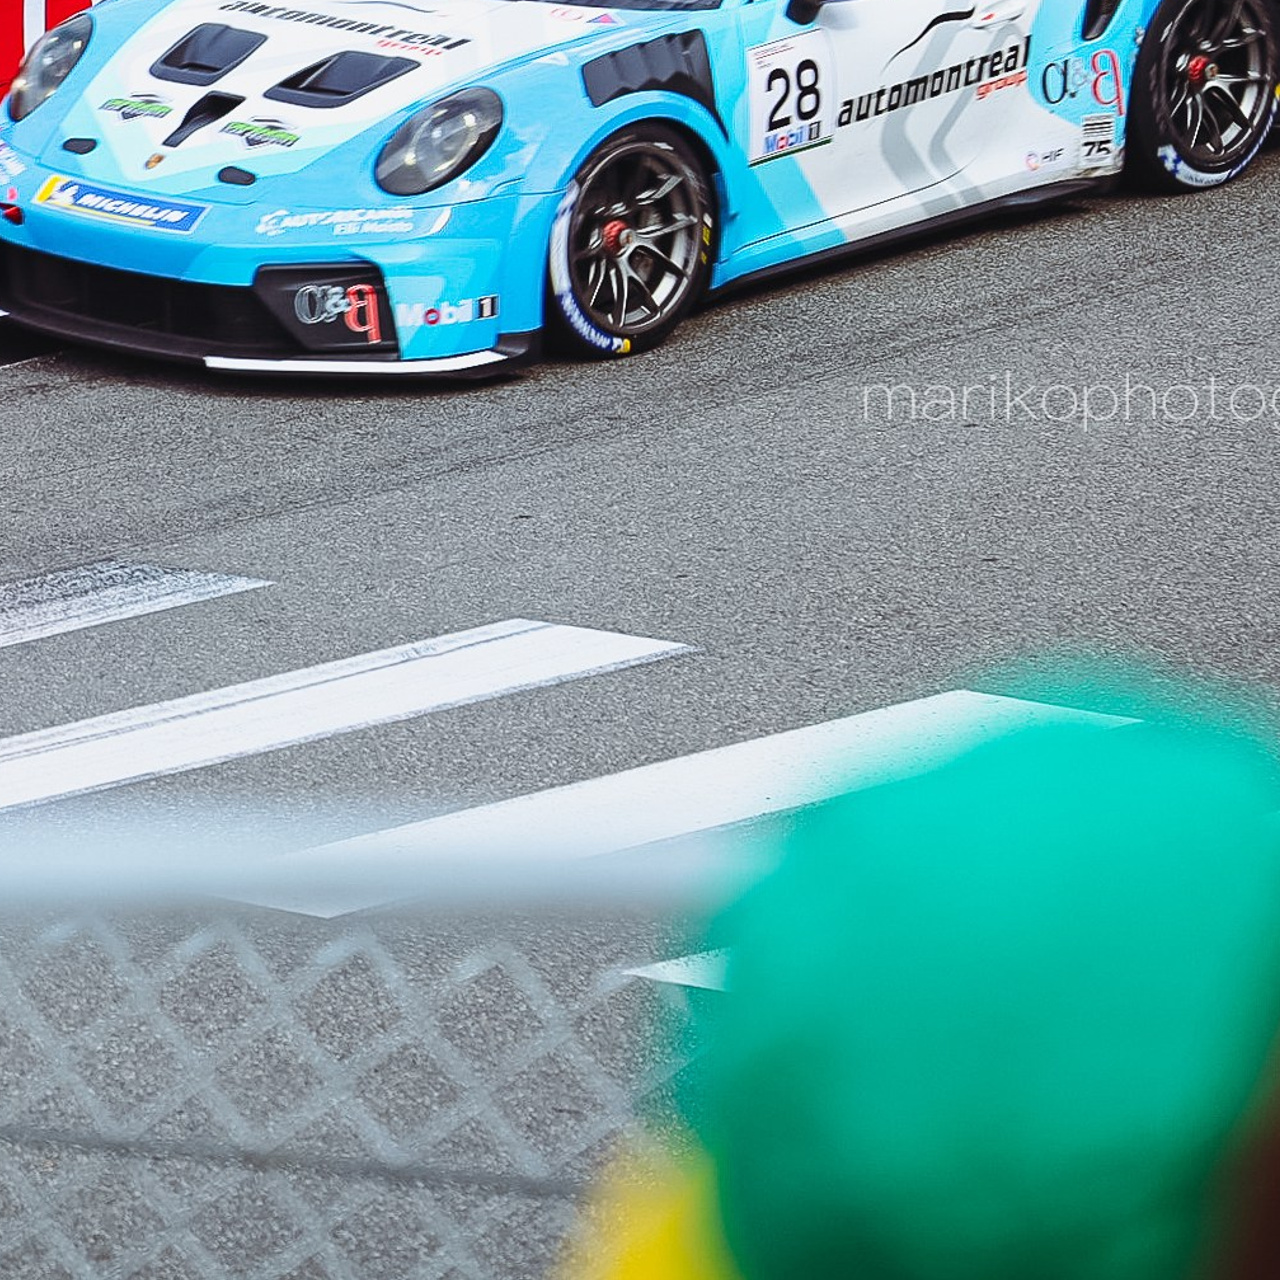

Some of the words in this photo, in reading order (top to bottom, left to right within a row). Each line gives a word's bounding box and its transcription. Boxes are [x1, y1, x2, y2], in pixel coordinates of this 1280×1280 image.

[766, 59, 820, 132] 28
[837, 35, 1031, 128] automontreal
[976, 70, 1027, 101] group
[764, 125, 805, 154] Mobil
[1082, 140, 1111, 157] 75
[396, 299, 473, 328] Mobil
